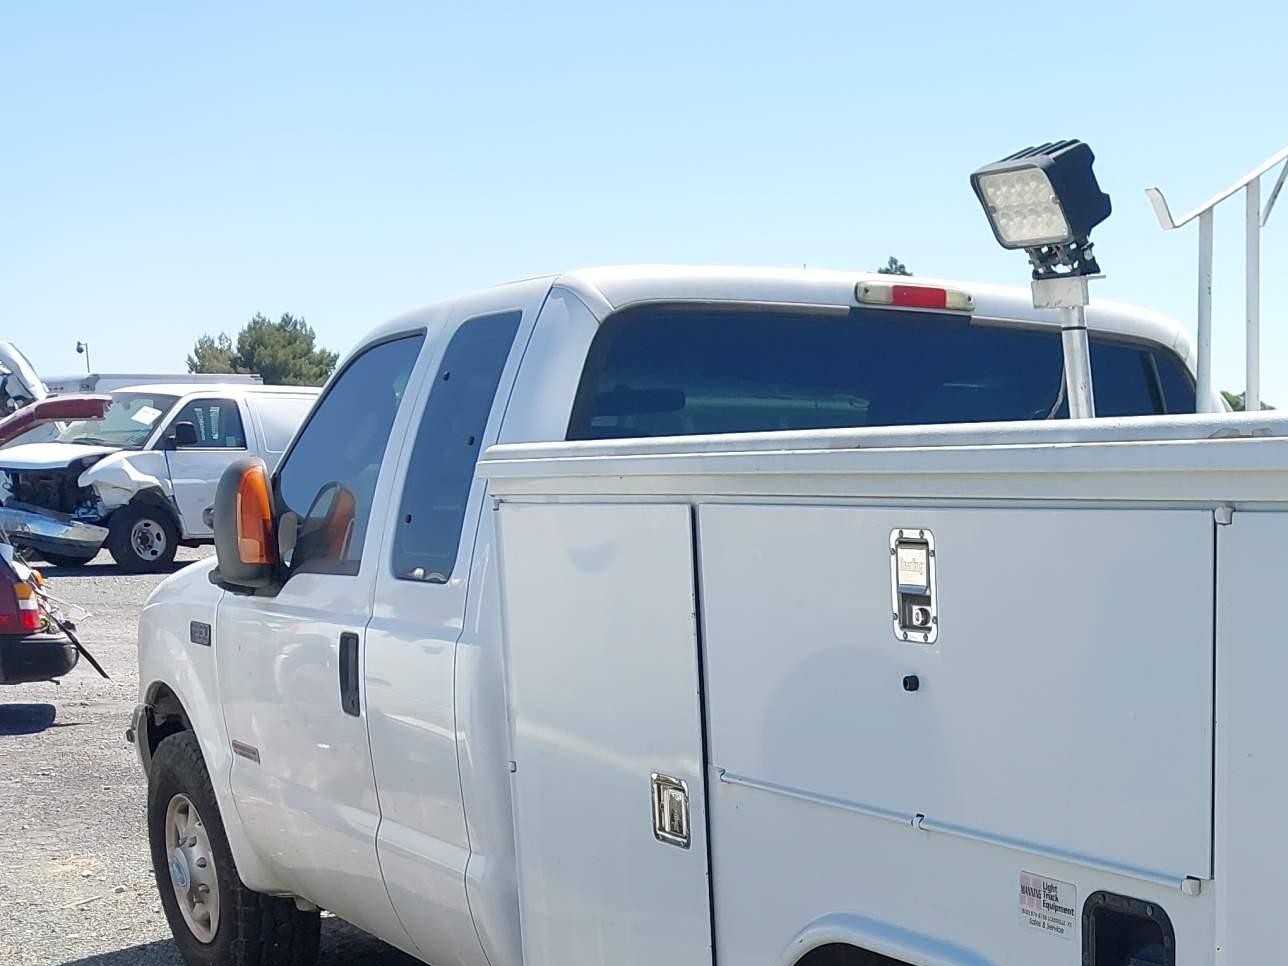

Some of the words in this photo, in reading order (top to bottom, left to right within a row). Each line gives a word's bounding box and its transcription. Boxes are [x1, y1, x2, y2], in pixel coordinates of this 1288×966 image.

[1042, 881, 1058, 894] Light
[1043, 890, 1059, 902] Truck
[1042, 899, 1075, 917] Equipment
